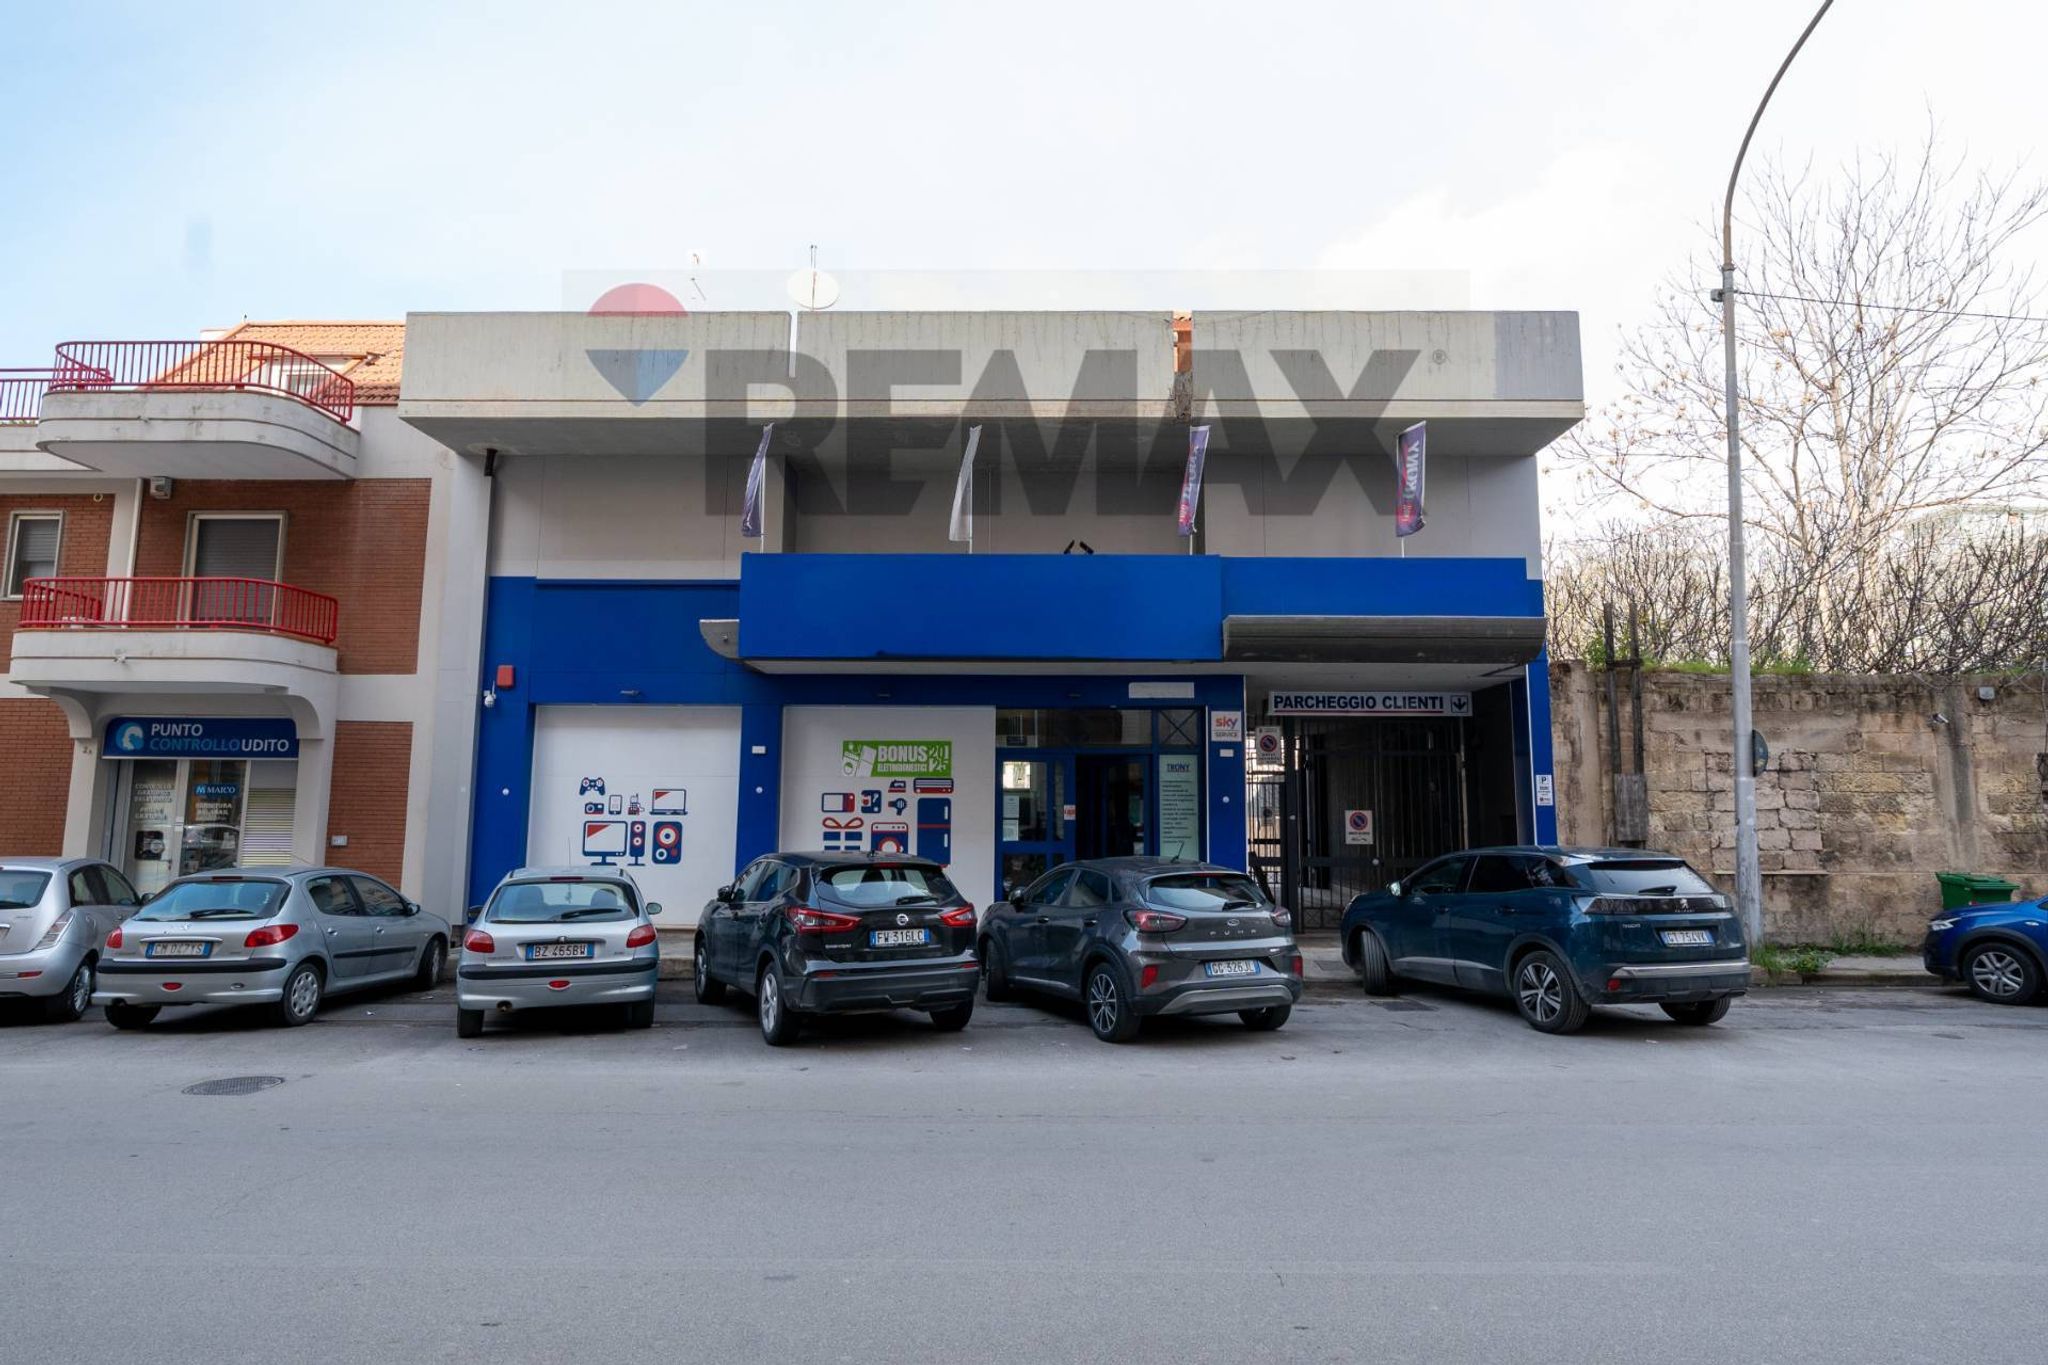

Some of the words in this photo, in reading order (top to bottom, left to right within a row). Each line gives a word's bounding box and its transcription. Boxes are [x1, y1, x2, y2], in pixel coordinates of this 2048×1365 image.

[1273, 695, 1376, 709] PARCHEGGIO
[1382, 696, 1443, 709] CLIENTI
[1215, 716, 1238, 729] sky
[151, 723, 203, 736] PUNTO
[878, 745, 928, 762] BONUS
[207, 786, 236, 794] MAICO
[877, 932, 890, 943] FW
[894, 930, 923, 942] 316LC
[534, 945, 549, 957] BZ
[552, 944, 586, 956] 465BW
